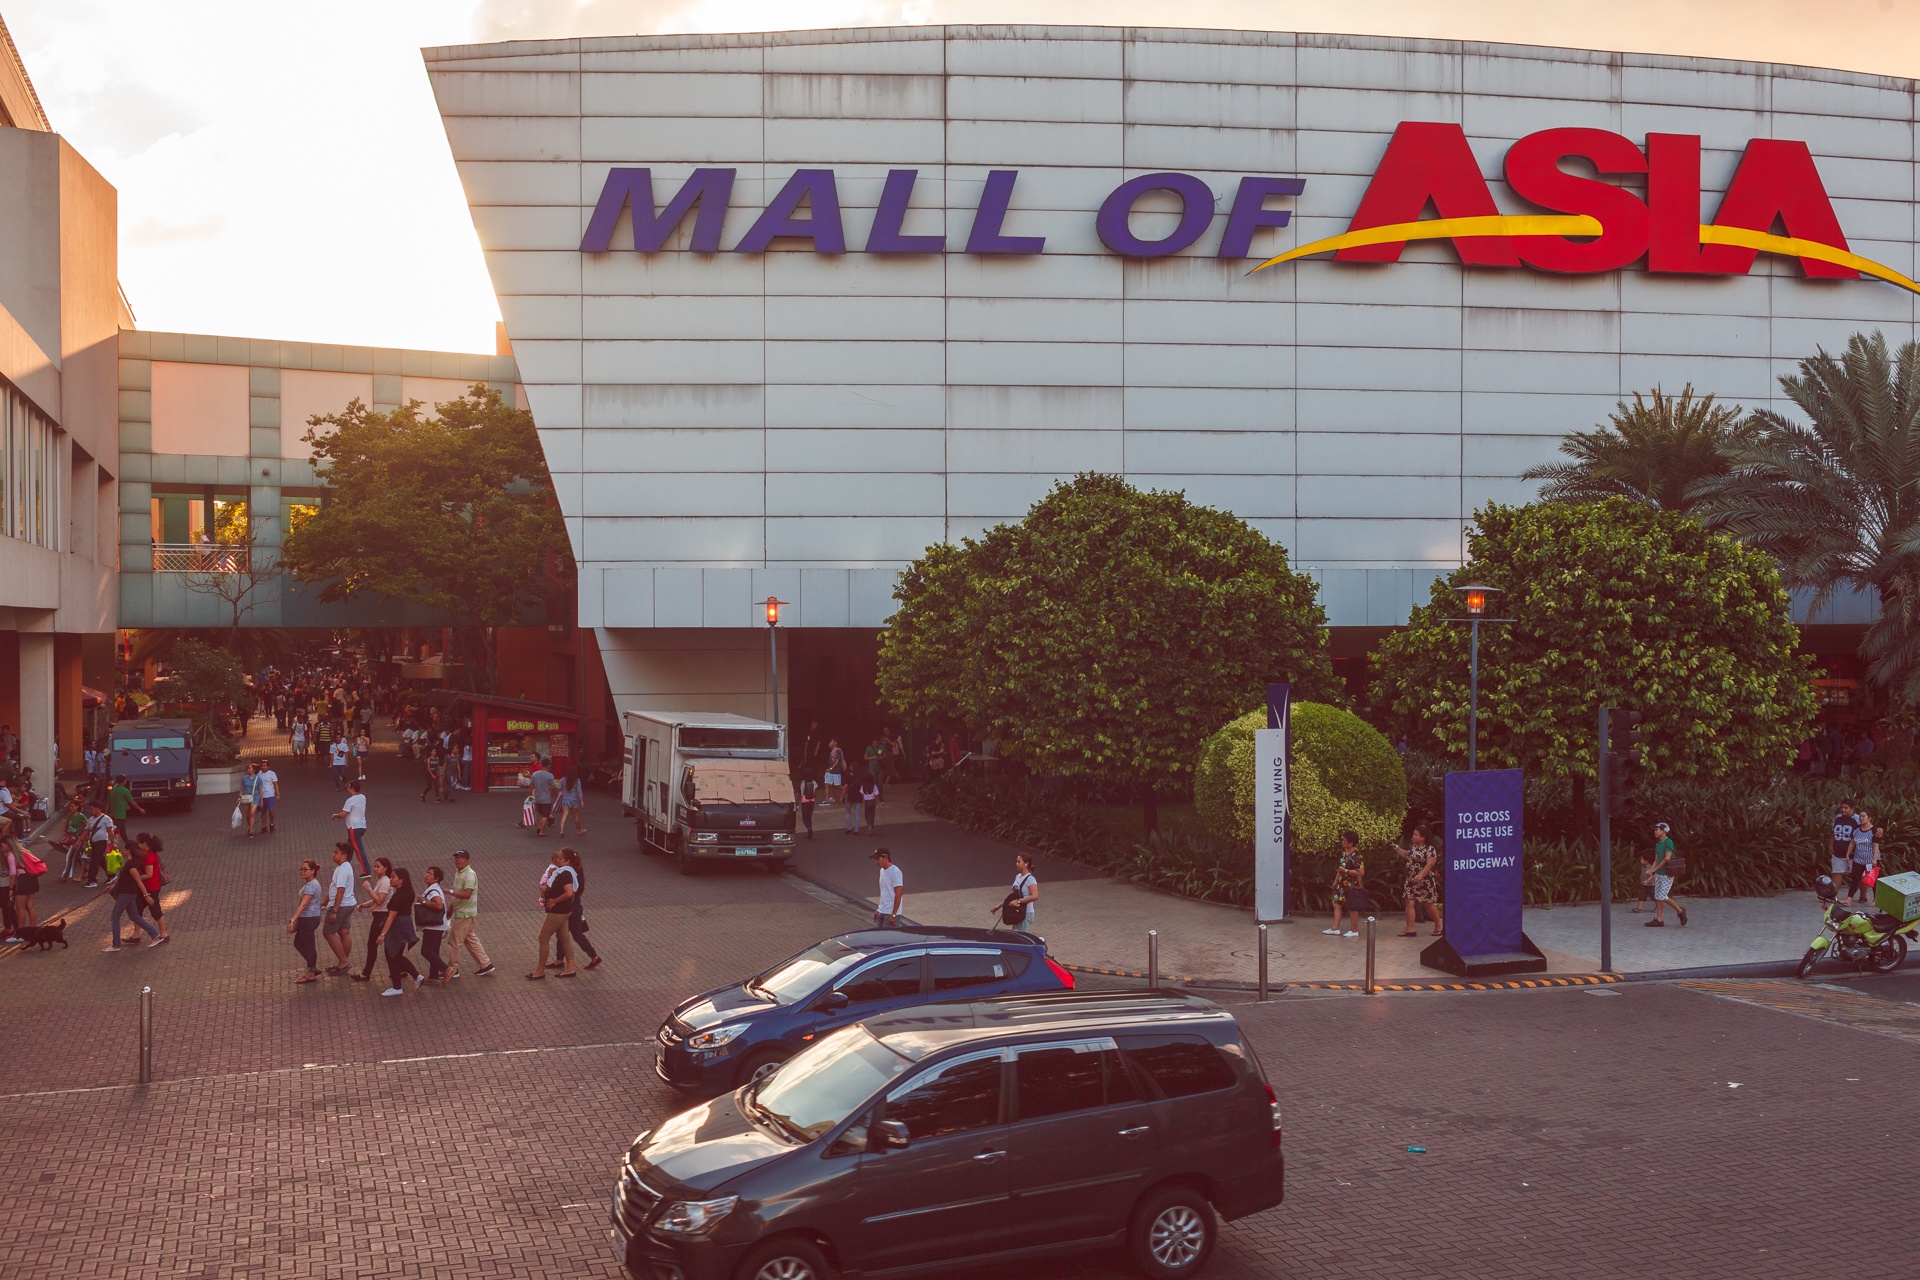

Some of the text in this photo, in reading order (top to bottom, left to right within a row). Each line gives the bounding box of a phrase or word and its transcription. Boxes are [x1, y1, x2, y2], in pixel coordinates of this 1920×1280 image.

[579, 121, 1862, 280] MALL OF ASIA
[1273, 757, 1283, 843] SOUTH WING
[1458, 810, 1510, 823] TO CROSS
[1456, 825, 1513, 839] PLEASE USE
[1475, 842, 1494, 853] THE
[1453, 856, 1516, 870] BRIDGEWAY
